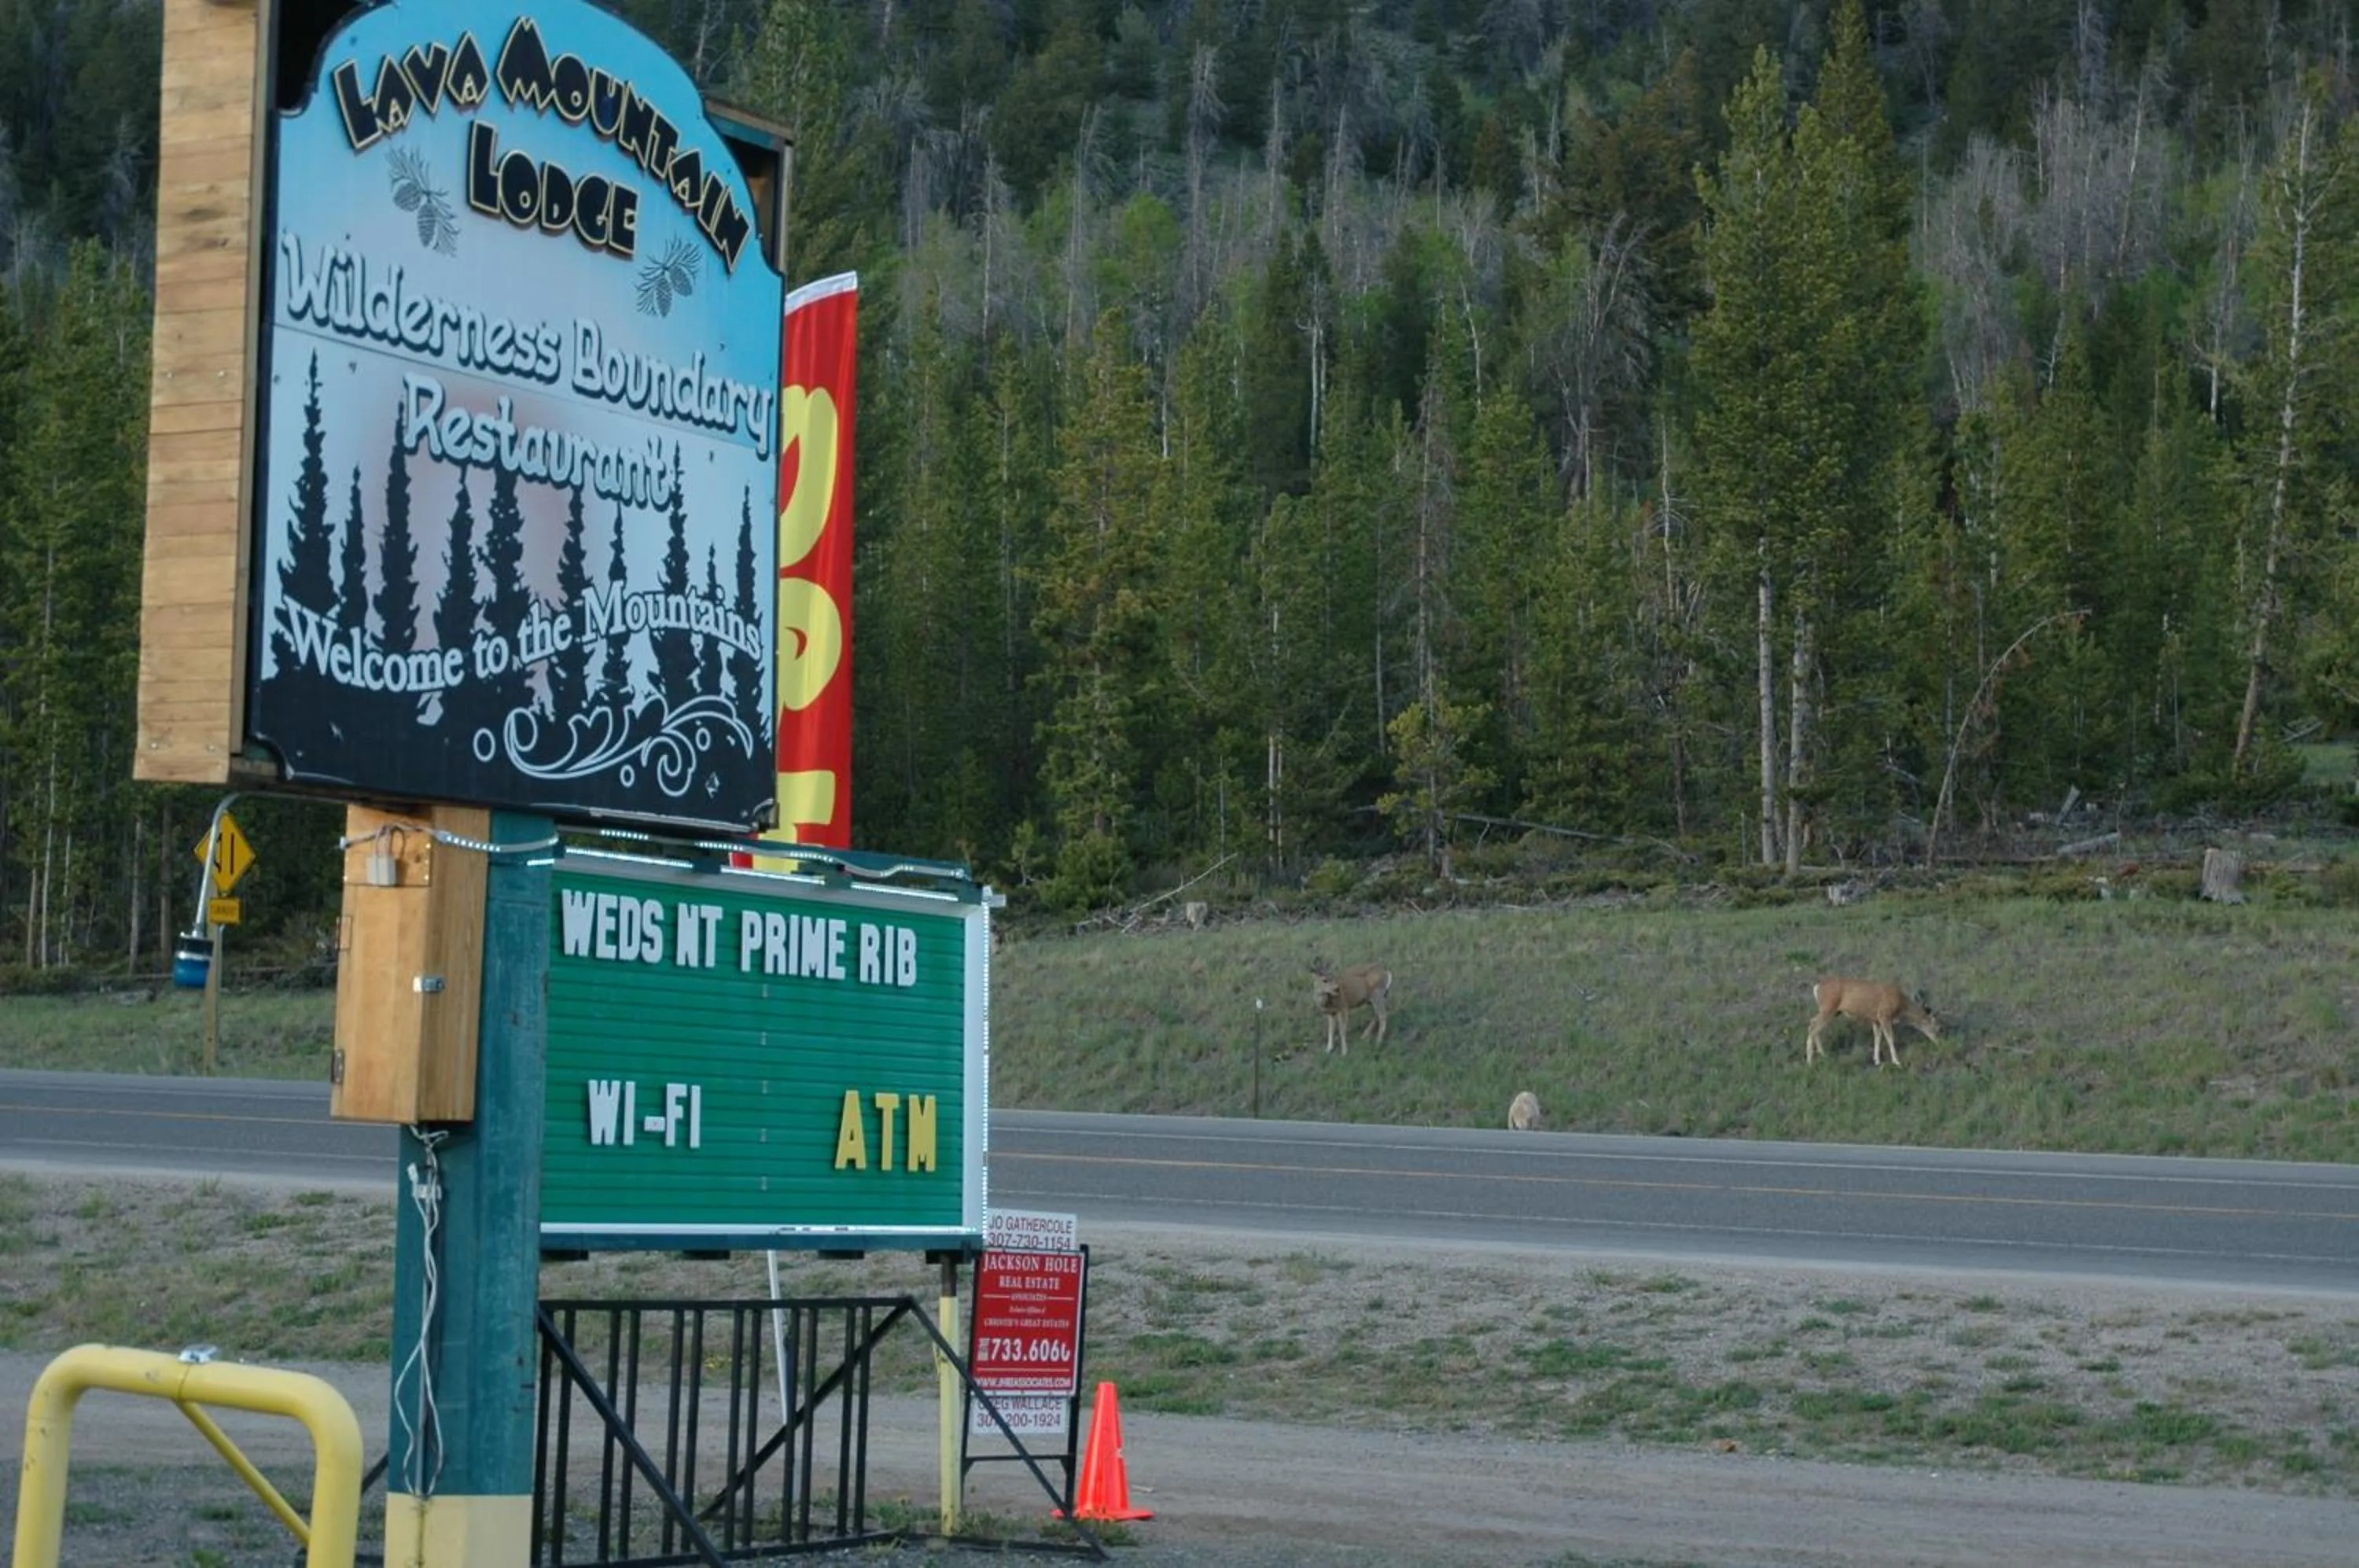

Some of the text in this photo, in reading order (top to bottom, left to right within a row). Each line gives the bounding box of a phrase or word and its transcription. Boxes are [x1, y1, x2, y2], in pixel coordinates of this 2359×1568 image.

[332, 16, 752, 274] LAVA MOUNTAIN
[469, 120, 639, 258] LODGE
[280, 234, 775, 461] Wilderness Boundary
[402, 373, 675, 512] Restaurant
[282, 580, 764, 693] Welcome to the Mountains
[561, 889, 917, 987] WEDS NT PRIME RIB
[588, 1079, 701, 1149] WI-FI
[834, 1089, 937, 1172] ATM
[983, 1253, 1079, 1273] JACKSON HOLE
[989, 1215, 1073, 1235] JO GATHERCOLE
[999, 1275, 1061, 1290] REAL ESTATE
